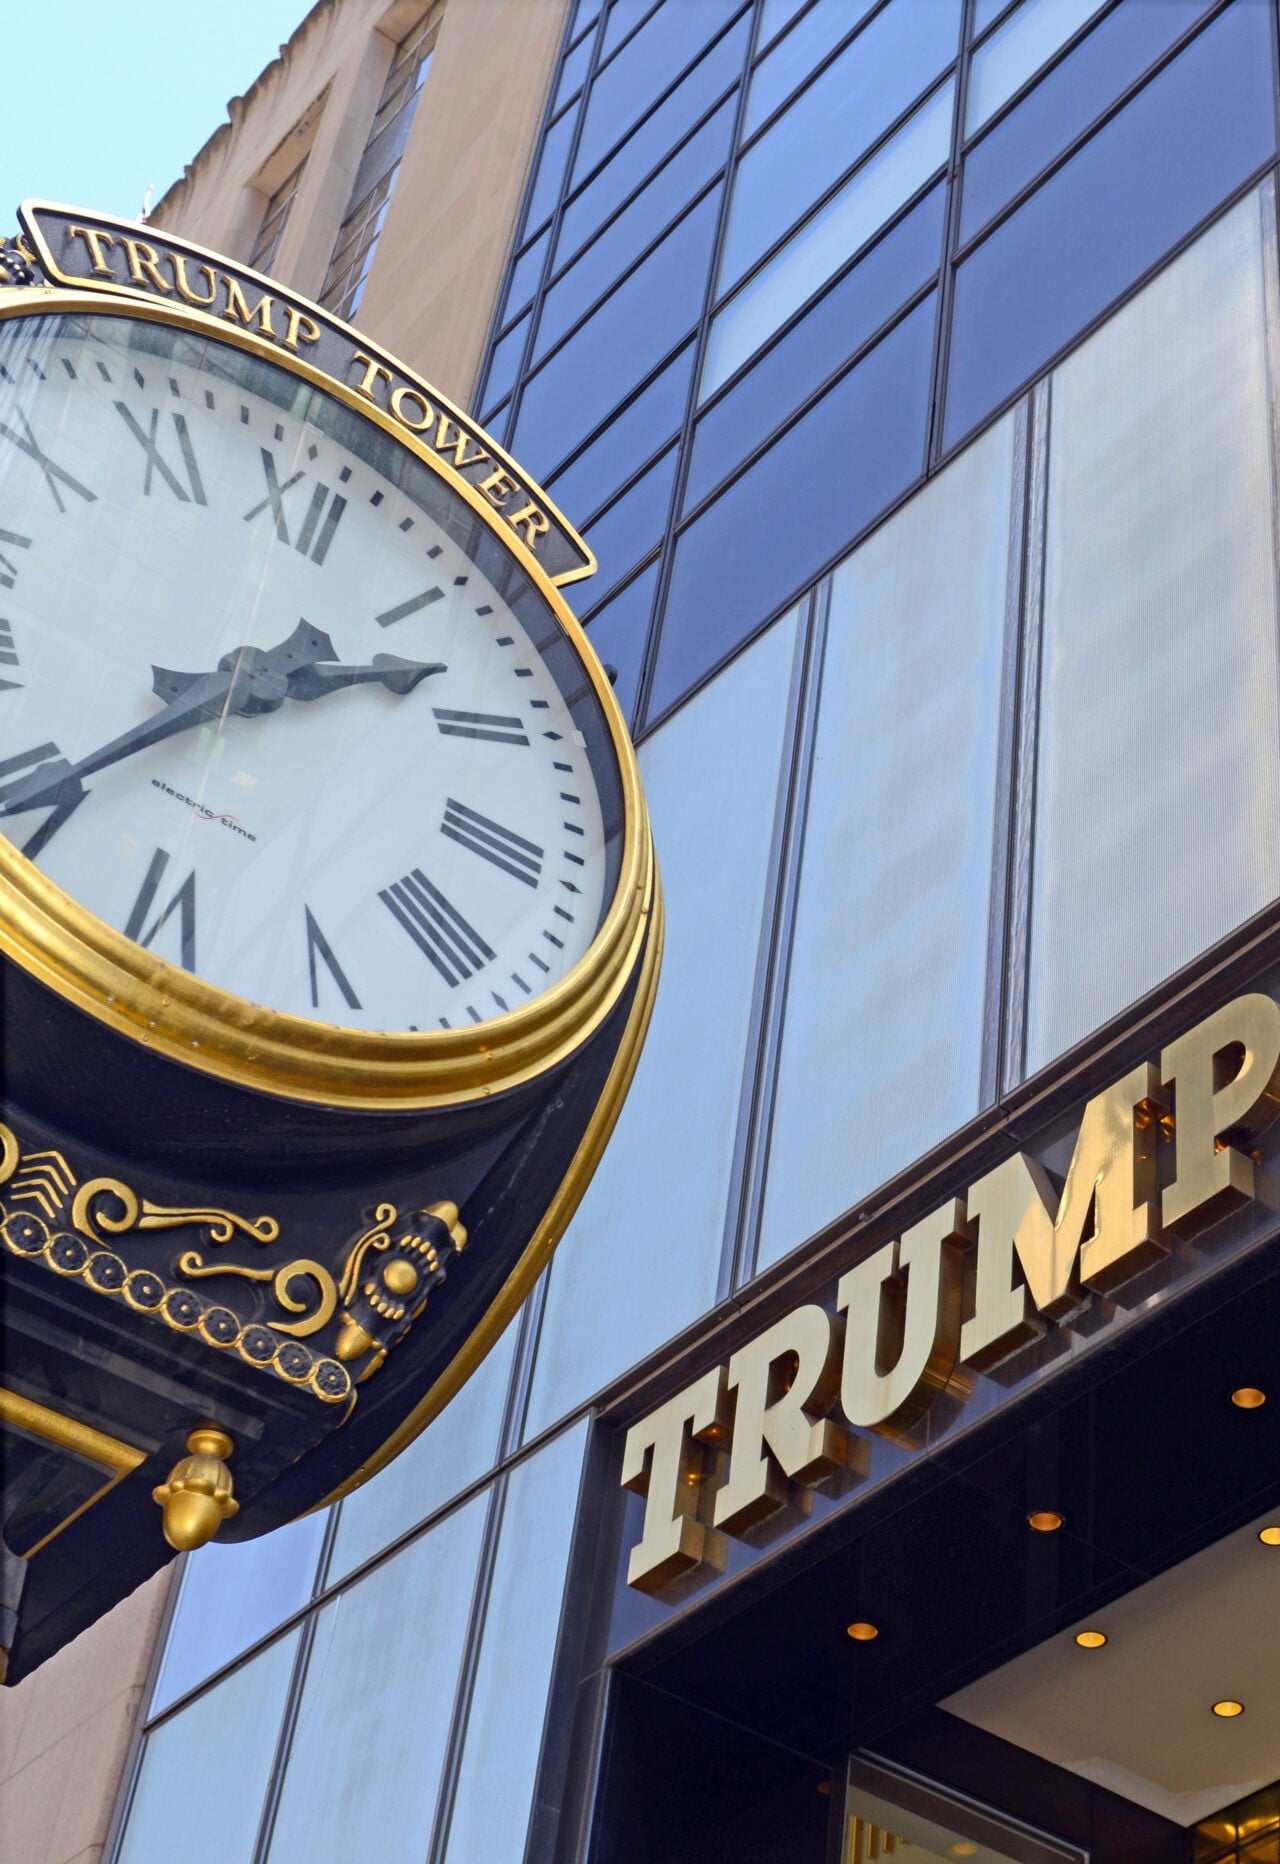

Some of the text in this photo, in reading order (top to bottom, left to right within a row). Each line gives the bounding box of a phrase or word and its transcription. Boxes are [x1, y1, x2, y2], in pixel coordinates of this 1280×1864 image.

[67, 224, 551, 550] TRUMP TOWER
[0, 404, 98, 513] X
[112, 400, 208, 506] XI
[243, 446, 348, 566] XII
[374, 585, 446, 628] I
[431, 707, 531, 747] II
[151, 779, 257, 842] electric time
[440, 797, 544, 889] III
[304, 902, 364, 1010] V
[377, 868, 497, 988] IIII
